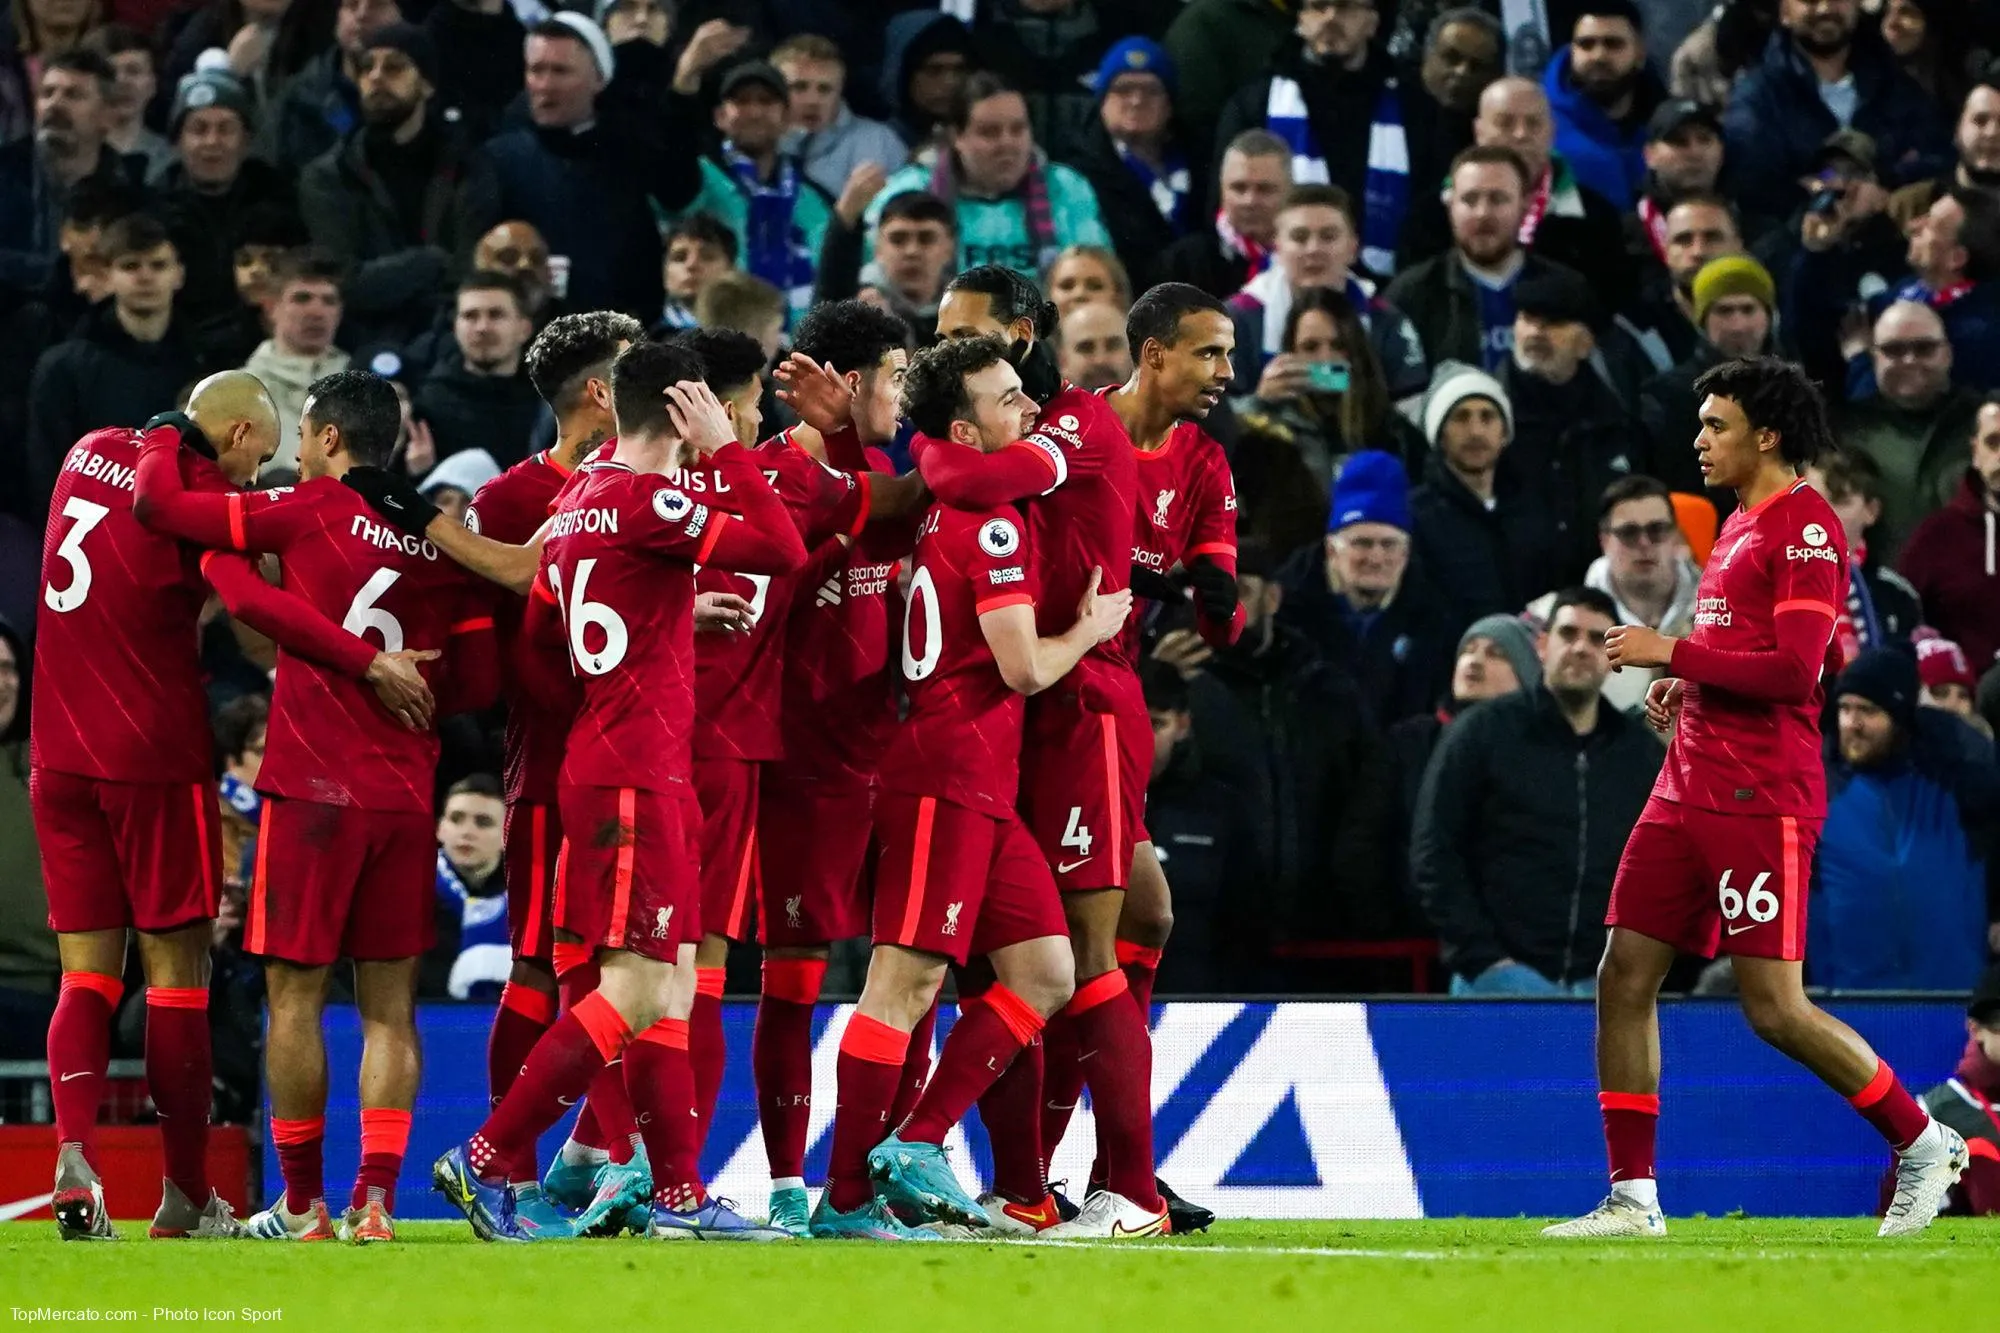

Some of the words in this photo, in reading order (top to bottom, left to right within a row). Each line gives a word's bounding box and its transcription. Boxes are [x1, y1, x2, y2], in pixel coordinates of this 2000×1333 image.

[1039, 423, 1083, 449] Expedia
[45, 496, 110, 613] 3
[351, 515, 438, 561] THIAGO
[1786, 545, 1838, 564] Expedia
[342, 567, 405, 654] 6
[1061, 806, 1093, 856] 4
[1719, 869, 1779, 923] 66
